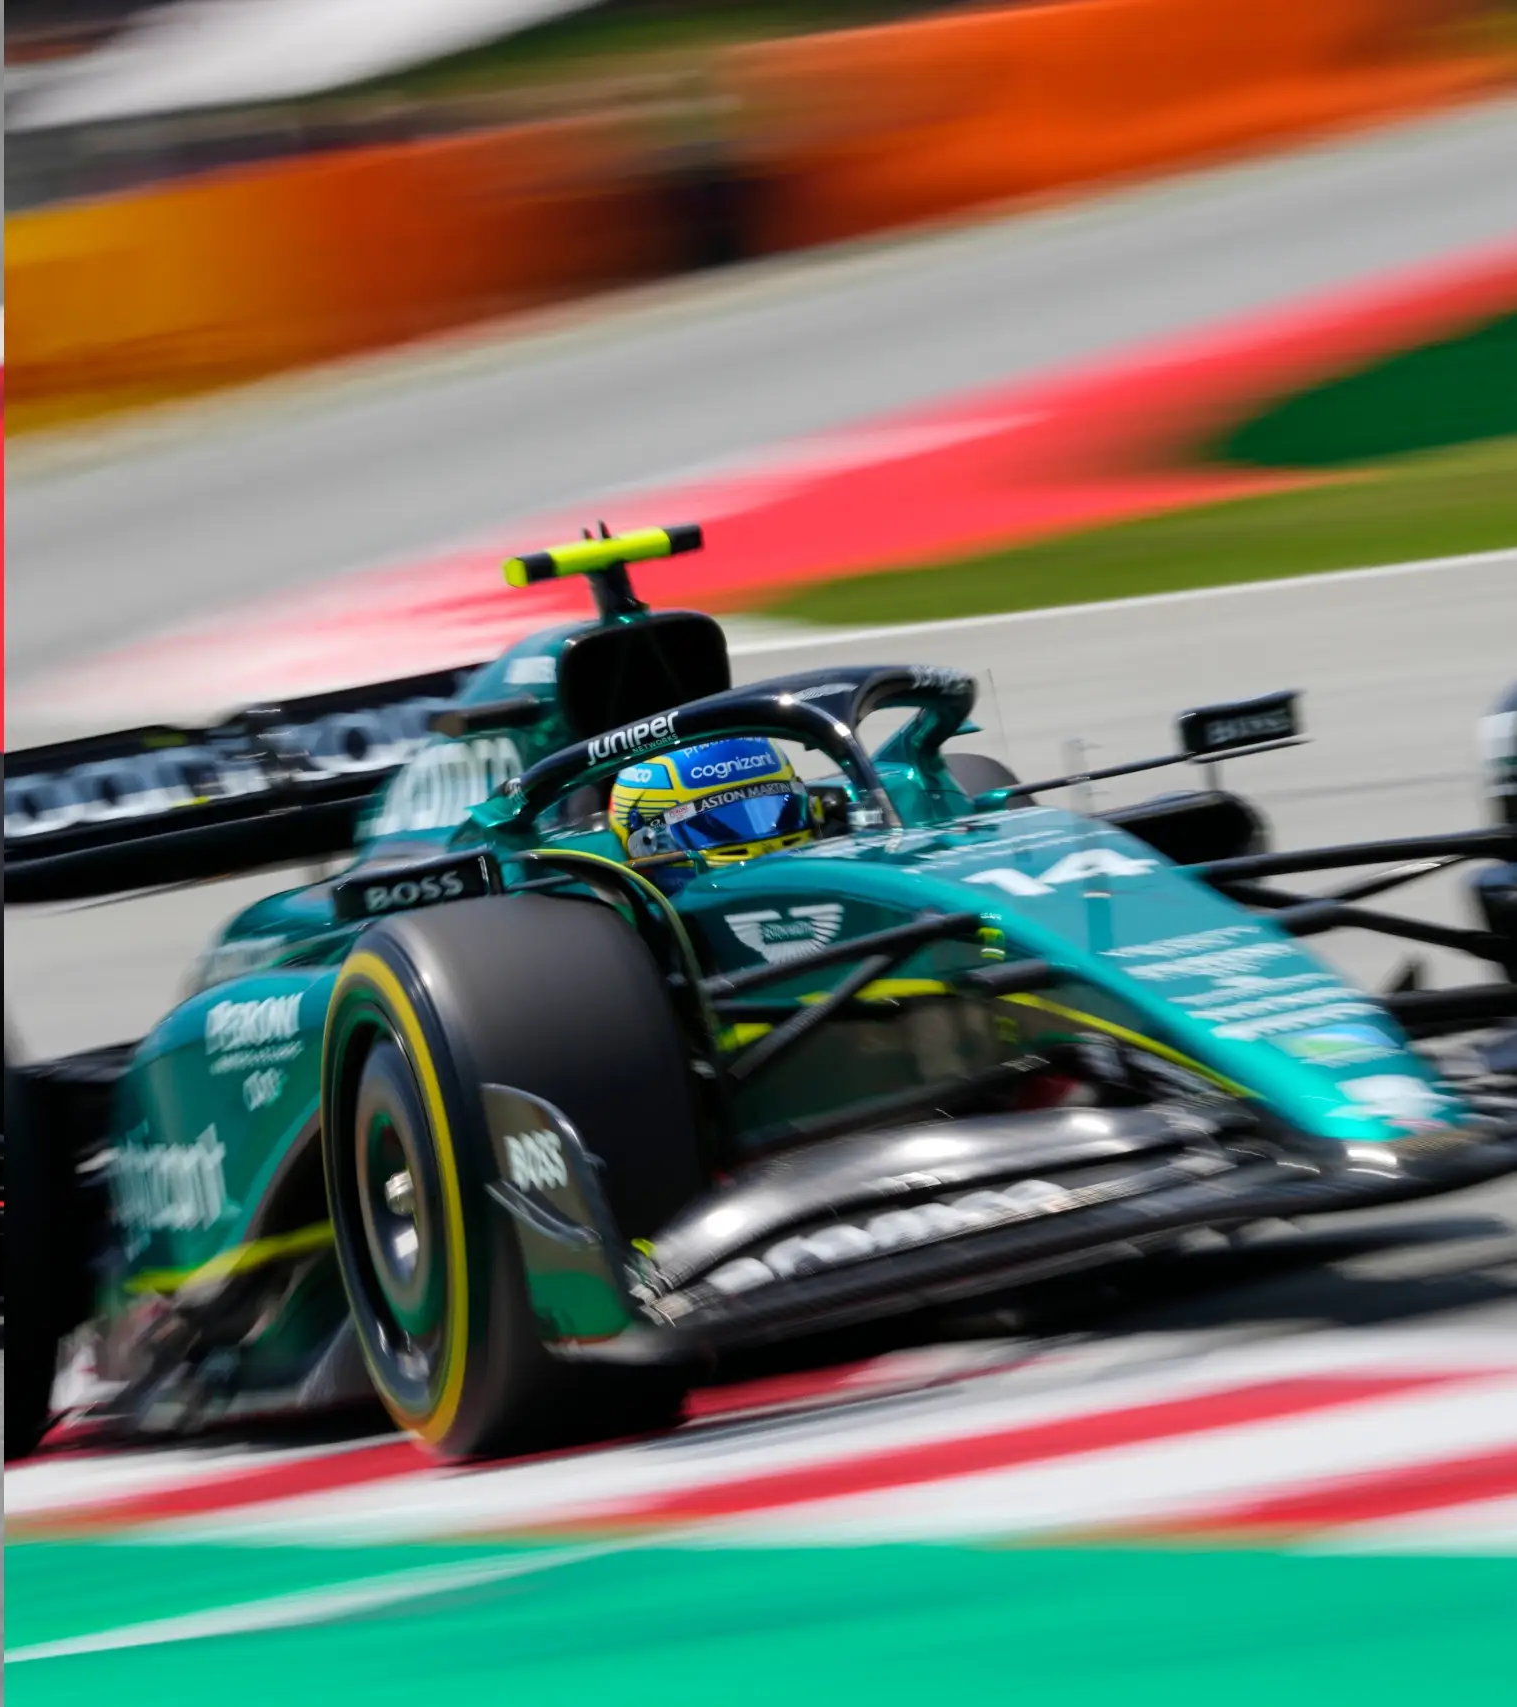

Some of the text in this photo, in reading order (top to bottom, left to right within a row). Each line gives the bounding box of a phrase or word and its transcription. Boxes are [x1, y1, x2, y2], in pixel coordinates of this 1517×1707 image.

[632, 733, 679, 755] NETWORKS
[691, 752, 777, 779] cognizant
[697, 783, 791, 812] ASTON MARTIN
[961, 848, 1160, 896] 14
[363, 870, 464, 912] BOSS
